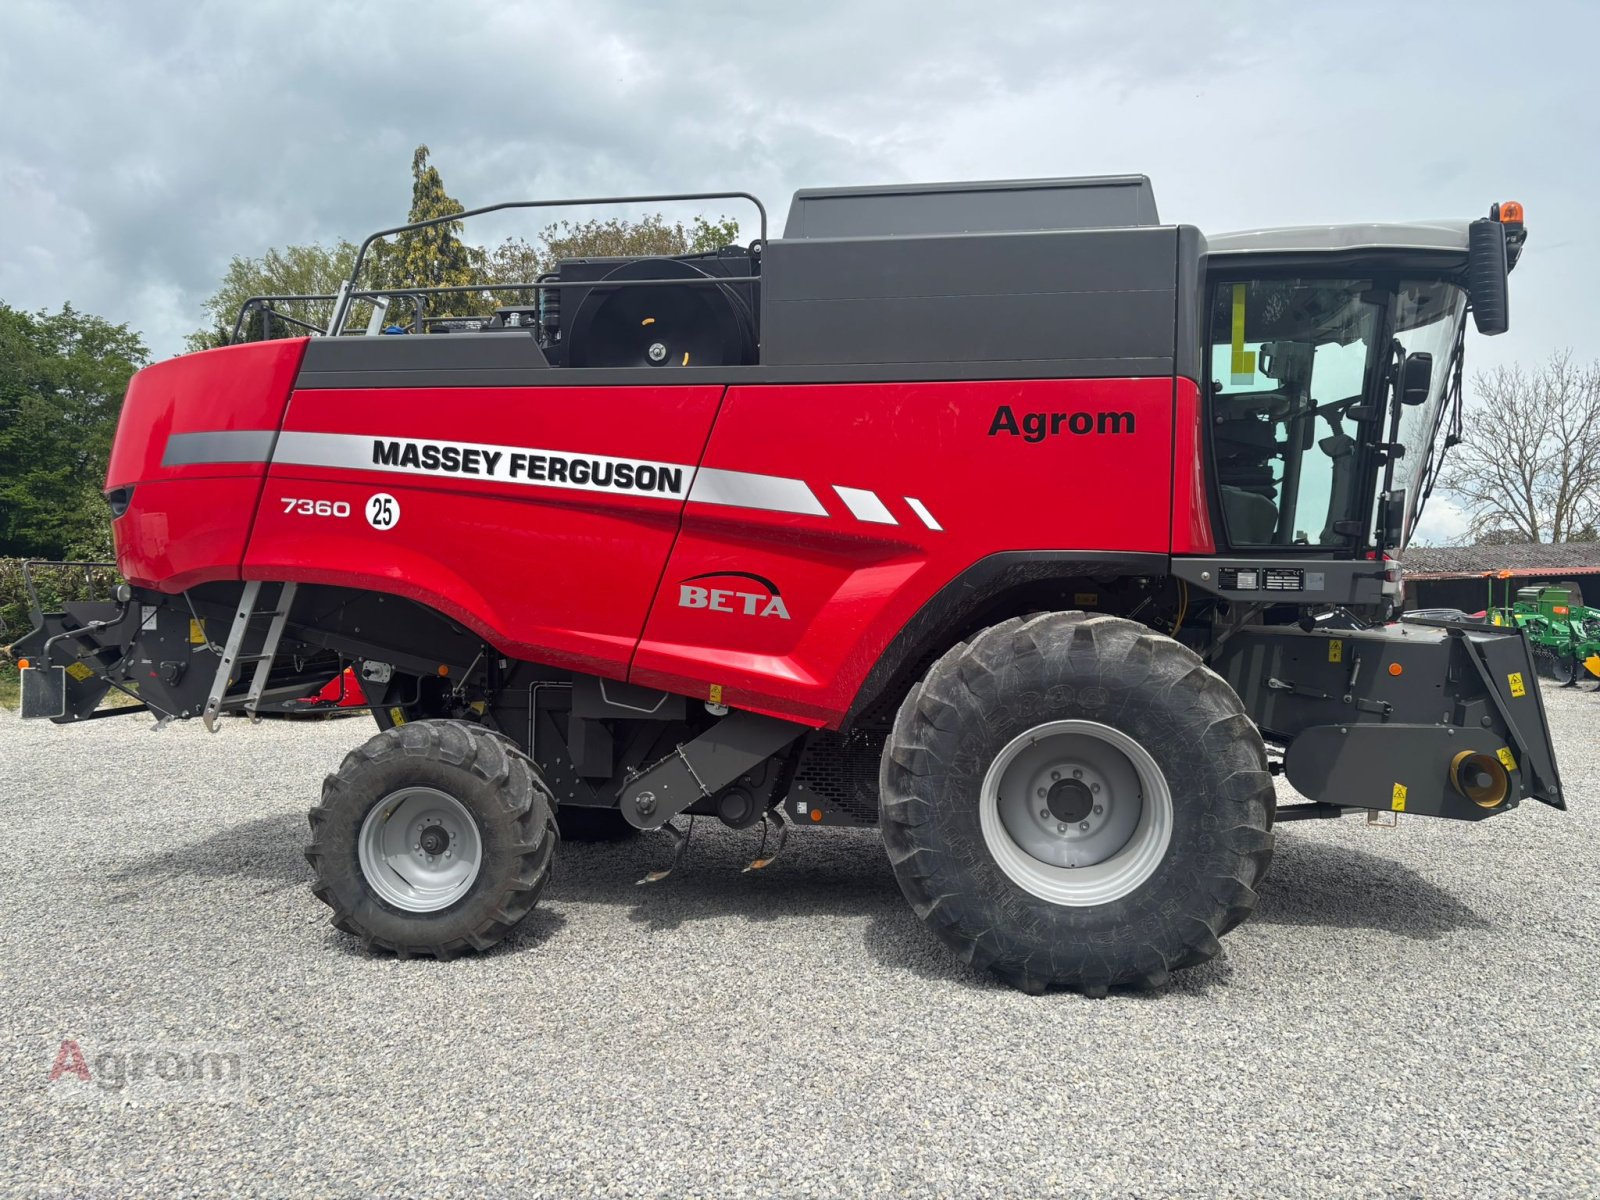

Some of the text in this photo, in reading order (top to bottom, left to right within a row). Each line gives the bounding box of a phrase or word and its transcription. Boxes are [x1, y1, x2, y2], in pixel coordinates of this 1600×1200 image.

[988, 405, 1135, 443] Agrom
[372, 440, 683, 494] MASSEY FERGUSON
[280, 497, 350, 518] 7360
[372, 497, 392, 526] 25
[678, 584, 791, 620] BETA
